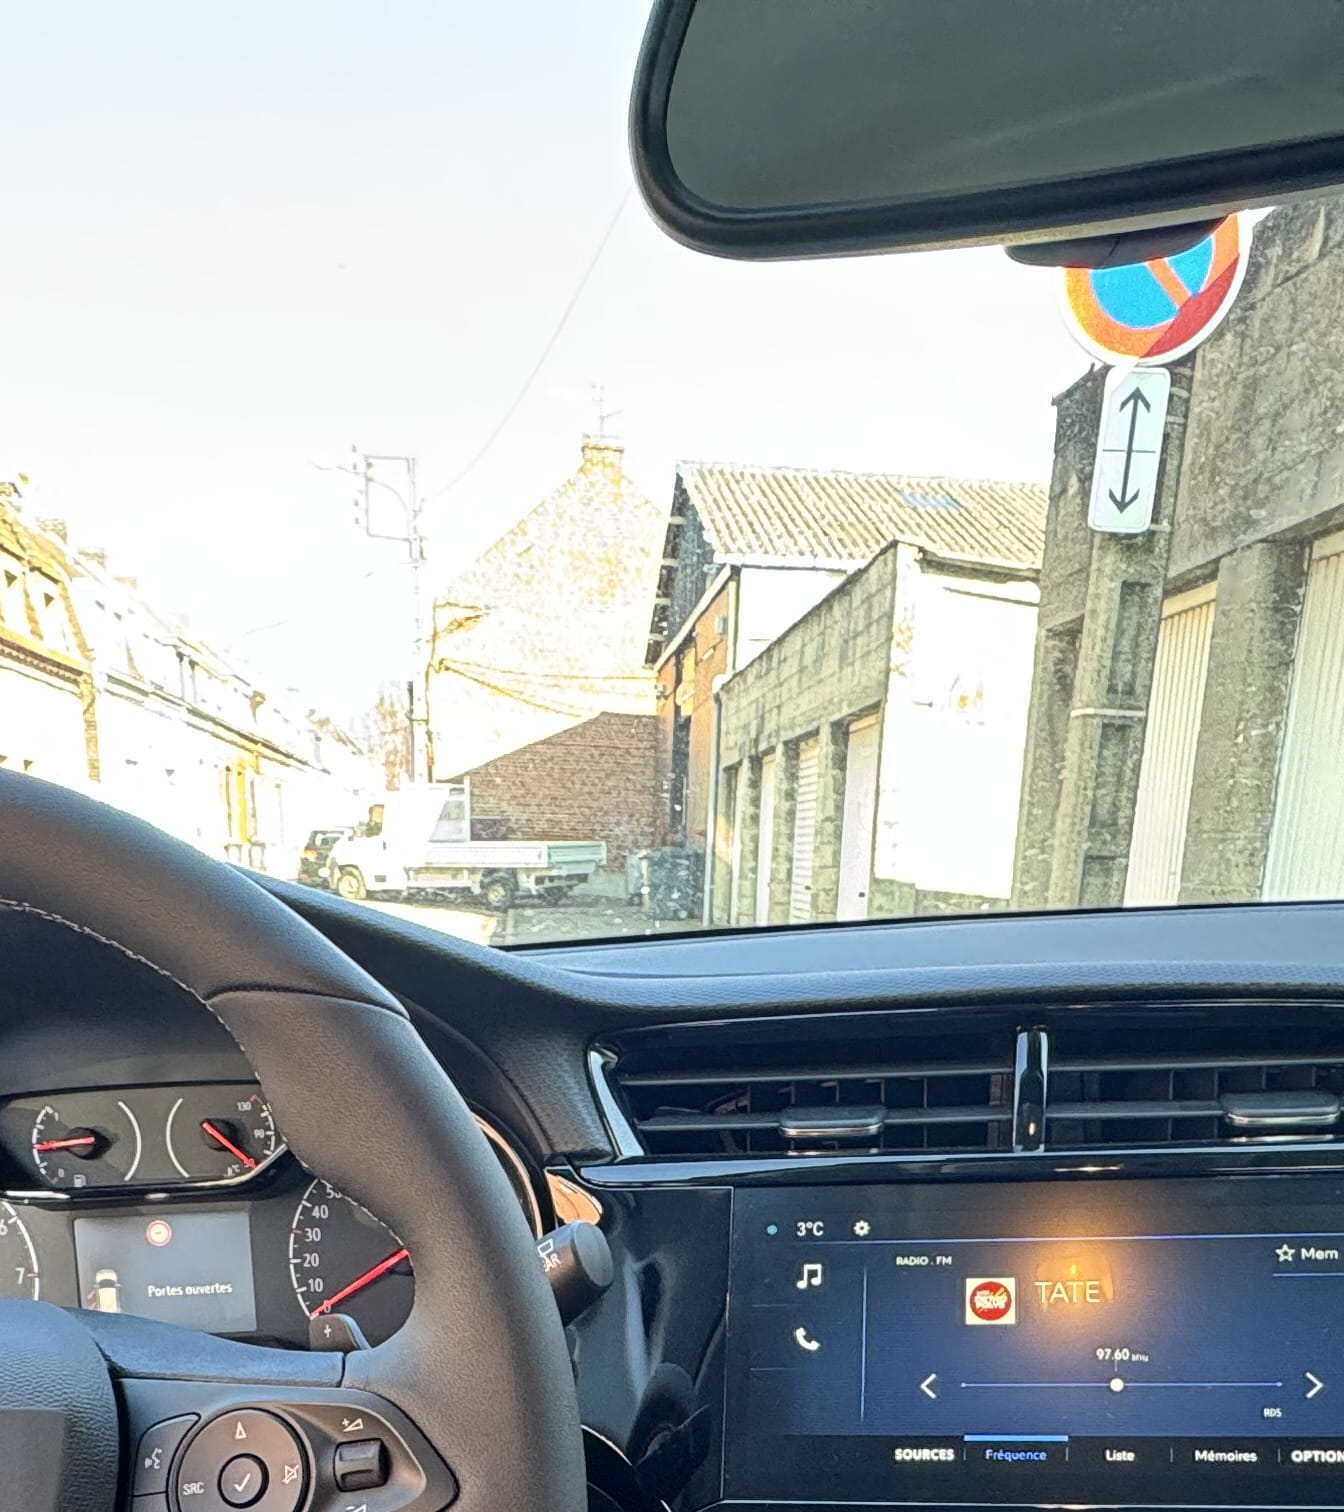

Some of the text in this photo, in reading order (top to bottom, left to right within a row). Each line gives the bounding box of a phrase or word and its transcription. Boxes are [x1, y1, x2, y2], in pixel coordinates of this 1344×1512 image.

[311, 1205, 329, 1219] 40
[304, 1228, 321, 1242] 30
[303, 1253, 319, 1267] 20
[896, 1255, 952, 1267] RADIO FM
[1300, 1247, 1339, 1261] Mem
[15, 1268, 25, 1285] 7
[147, 1282, 233, 1298] Portes ouvertes
[308, 1278, 323, 1292] 10
[1035, 1280, 1101, 1303] TATE
[1096, 1347, 1130, 1361] 97.60
[894, 1448, 955, 1461] SOURCES
[985, 1448, 1047, 1462] Fréquence
[1105, 1450, 1136, 1462] Liste
[1194, 1449, 1258, 1462] Mémoires
[183, 1481, 205, 1495] SRC
